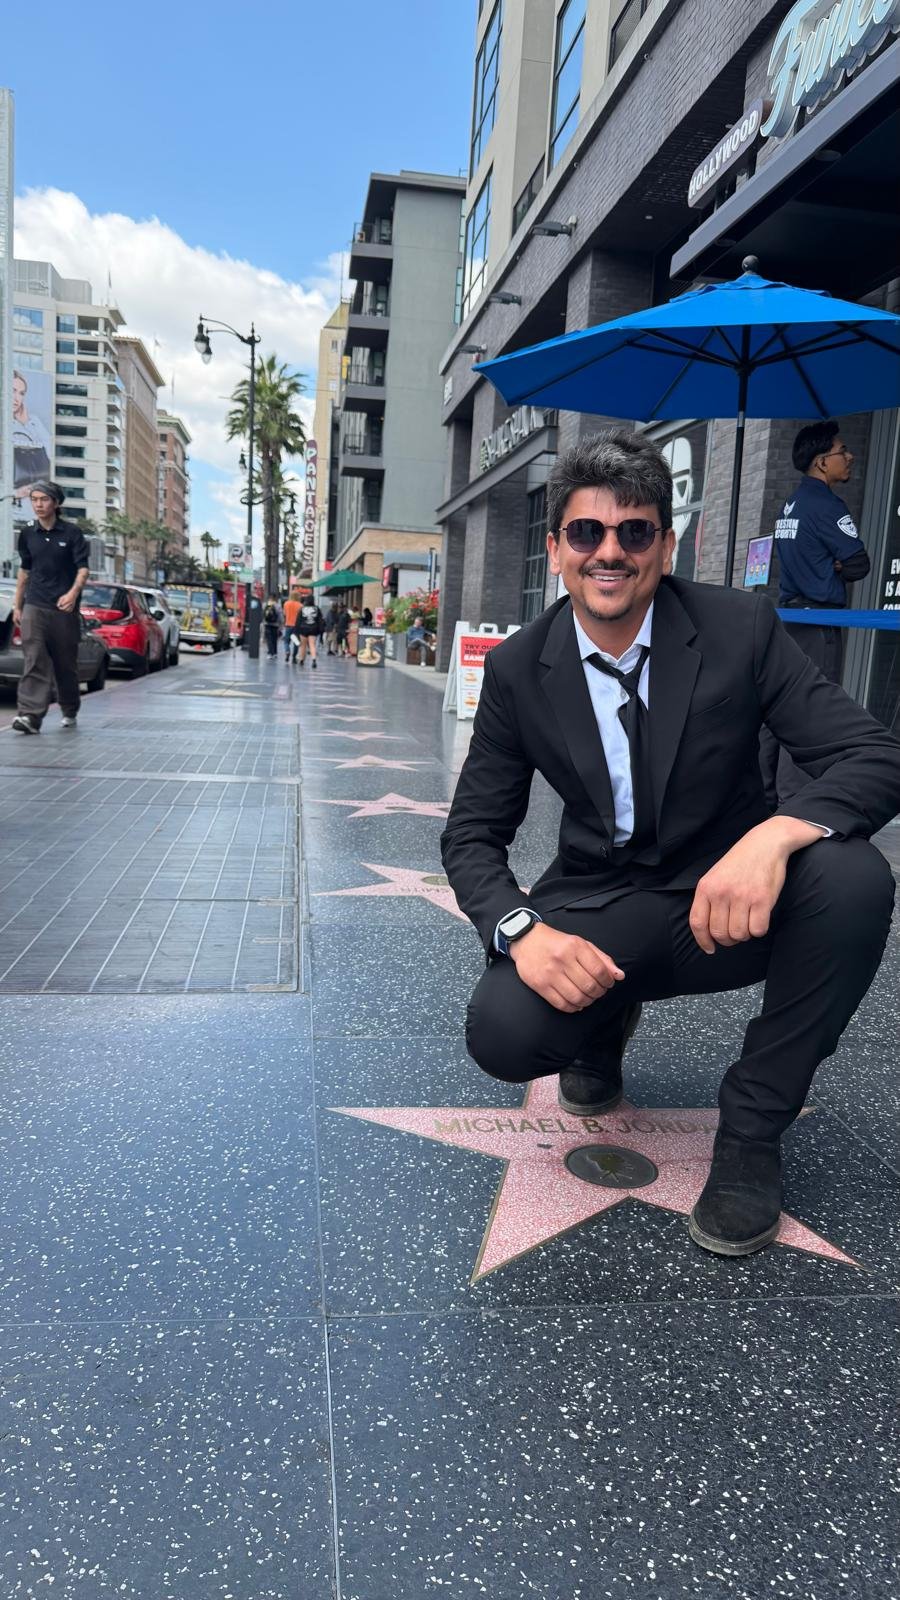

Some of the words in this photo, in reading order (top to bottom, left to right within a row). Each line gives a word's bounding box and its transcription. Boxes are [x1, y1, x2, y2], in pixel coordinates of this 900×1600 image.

[688, 110, 759, 199] HOLLYWOOD
[304, 447, 317, 560] PANTAGES
[885, 581, 895, 597] IS
[434, 1118, 577, 1133] MICHAEL
[582, 1118, 608, 1133] B.
[617, 1118, 719, 1134] JORDA
